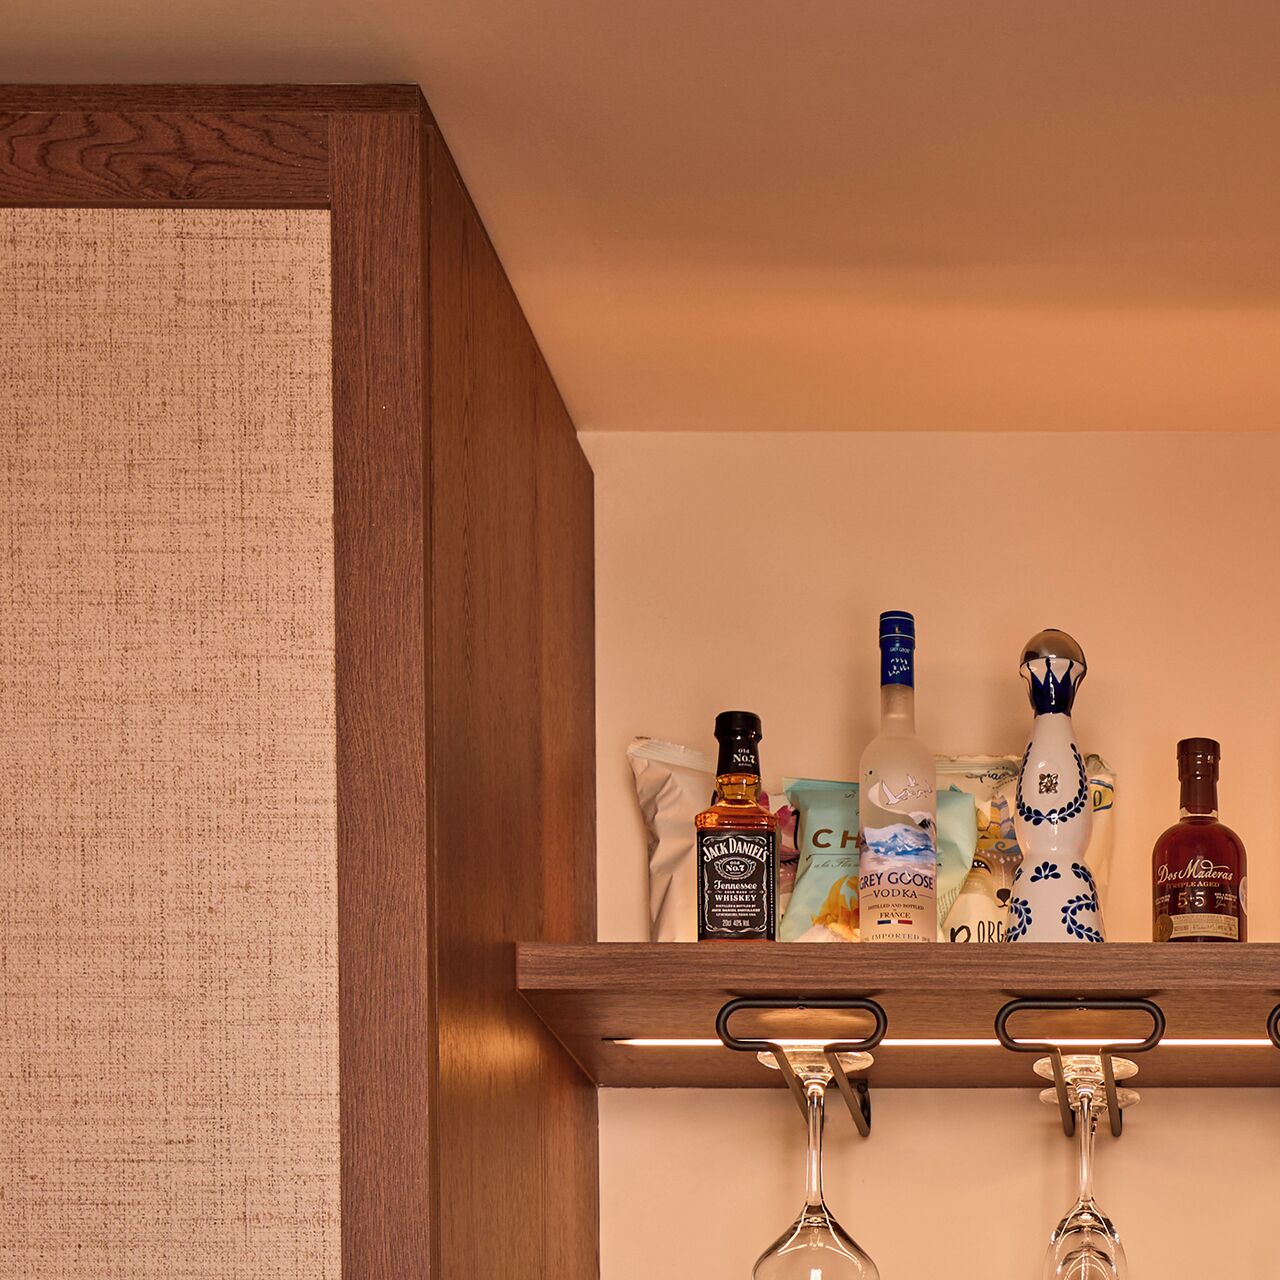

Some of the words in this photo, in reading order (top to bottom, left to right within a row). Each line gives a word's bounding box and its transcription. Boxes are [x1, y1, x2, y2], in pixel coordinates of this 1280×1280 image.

[703, 841, 729, 862] JACK
[728, 837, 770, 862] DANIEL'S
[860, 872, 883, 890] GREY
[887, 871, 934, 890] GOOSE
[1157, 863, 1178, 885] Dos
[1178, 859, 1233, 880] Maderas
[713, 880, 758, 890] Tennessee
[873, 888, 918, 898] VODKA
[977, 920, 1007, 943] ORG
